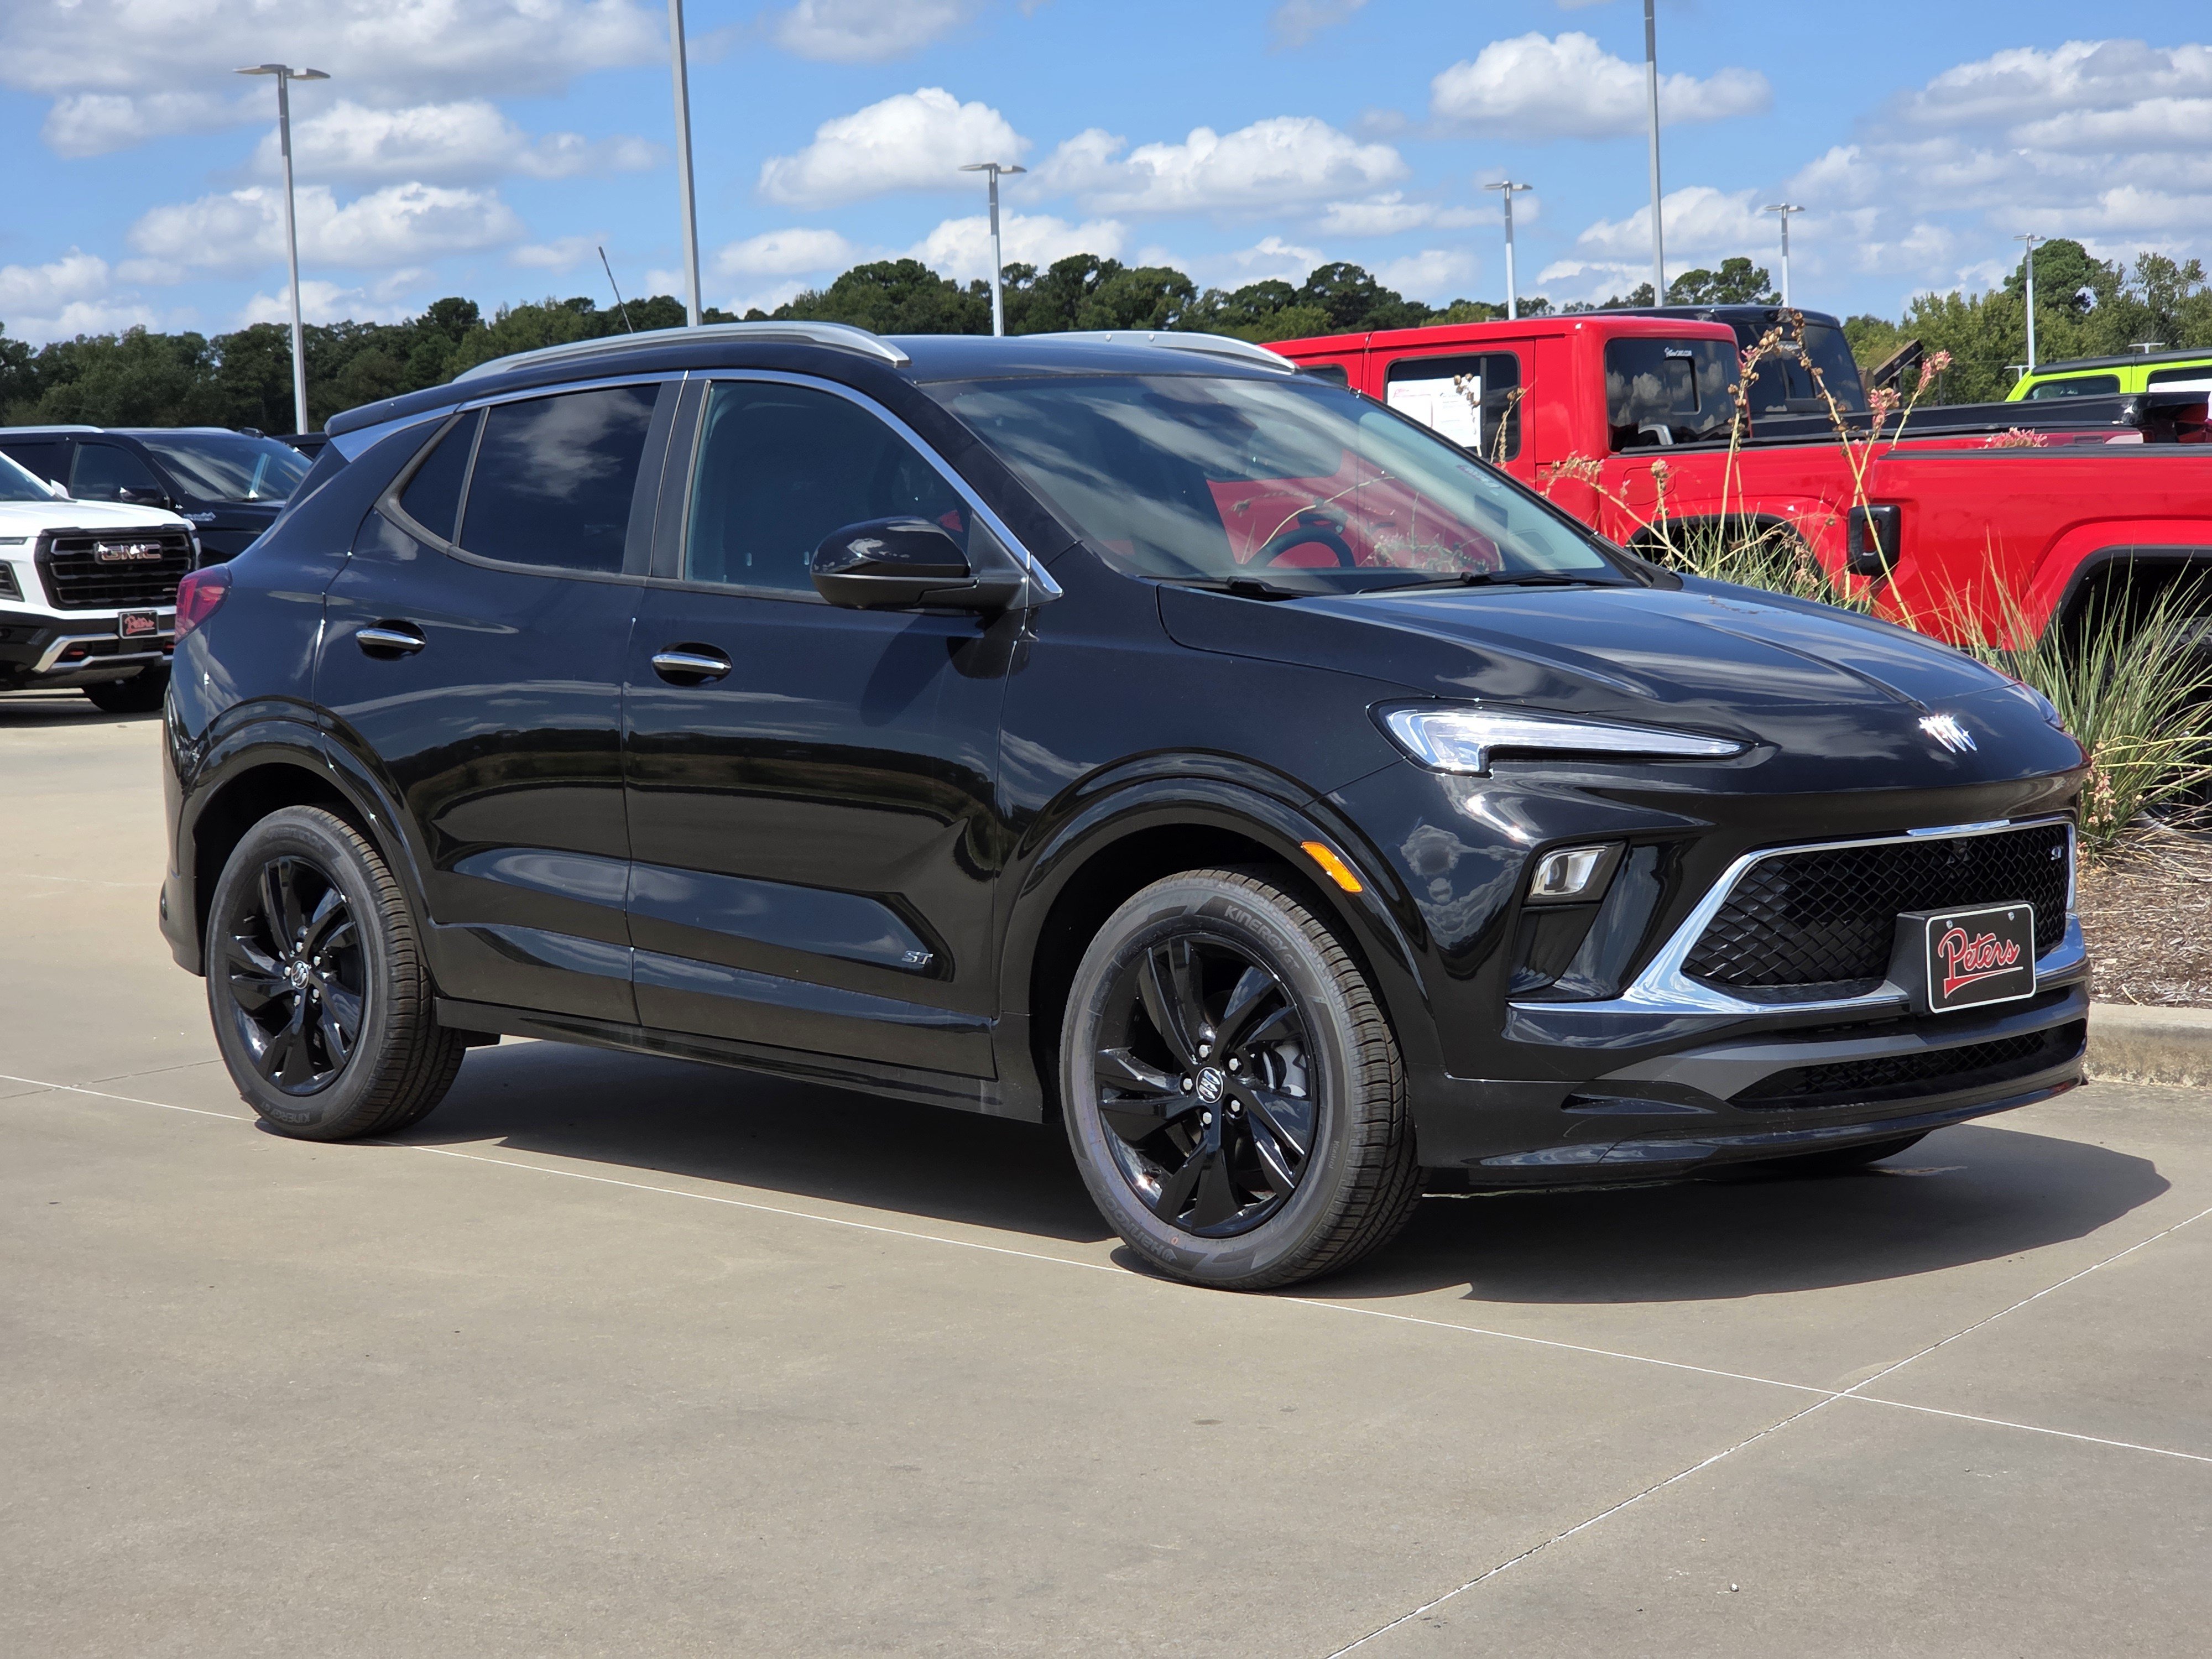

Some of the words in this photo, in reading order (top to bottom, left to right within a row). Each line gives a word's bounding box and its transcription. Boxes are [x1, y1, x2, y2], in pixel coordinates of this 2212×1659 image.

[100, 544, 161, 560] GMC
[1224, 905, 1288, 951] KINERGY
[1282, 953, 1300, 969] GT
[1938, 927, 2021, 982] Peters
[901, 950, 933, 965] ST
